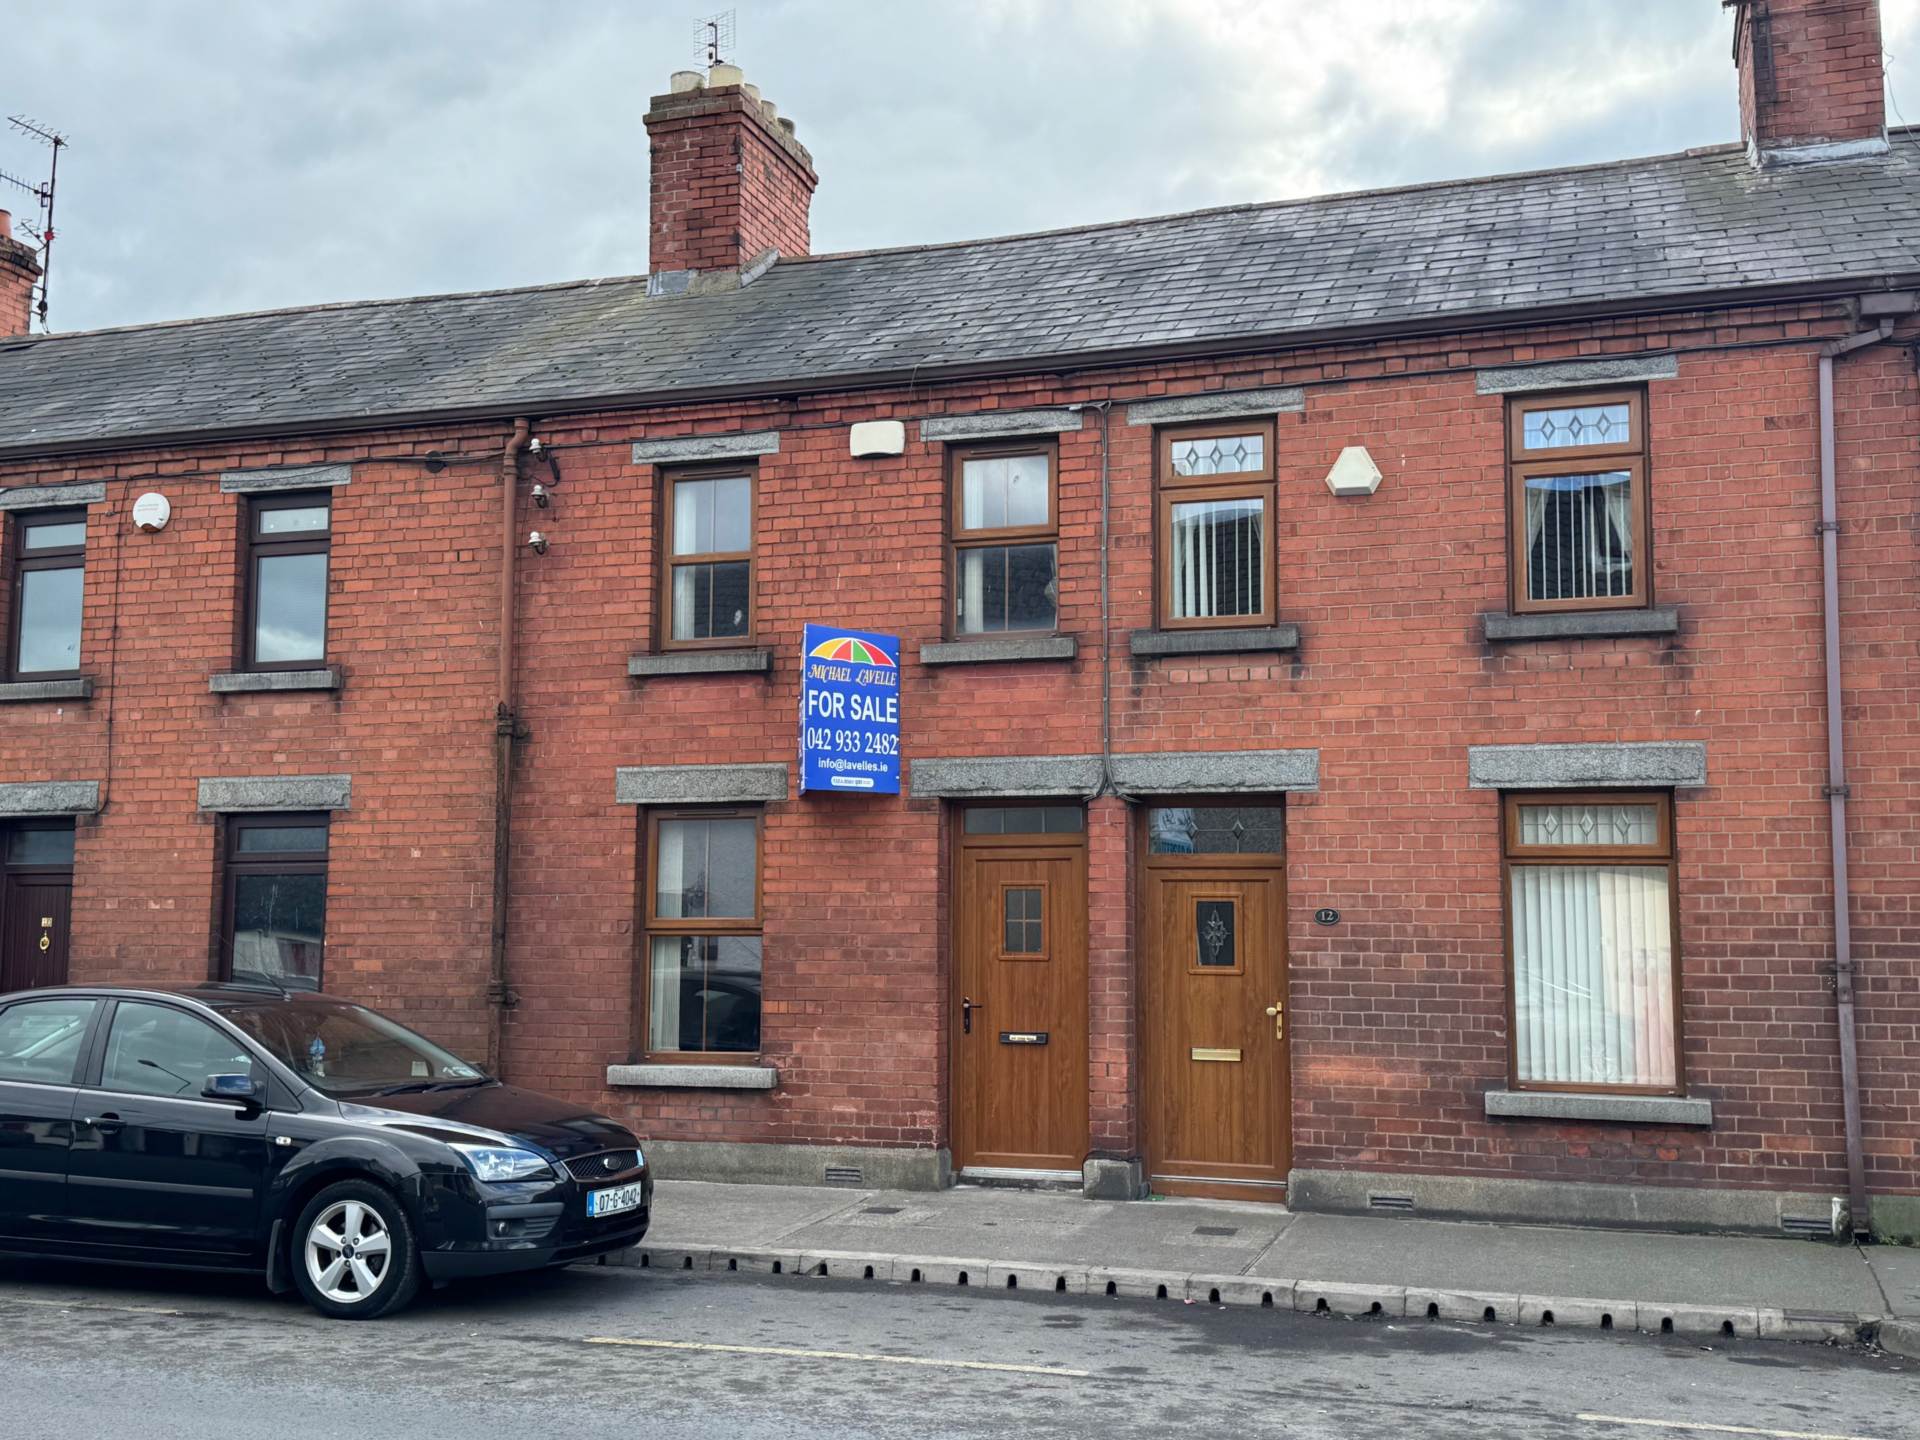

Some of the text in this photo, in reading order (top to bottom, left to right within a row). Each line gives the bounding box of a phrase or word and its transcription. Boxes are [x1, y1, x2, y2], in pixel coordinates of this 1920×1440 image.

[808, 664, 898, 686] MICHAEL LAVELLE
[808, 689, 898, 724] FOR SALE
[807, 726, 898, 755] 042 933 2482
[818, 757, 888, 772] info@lavelles.ie
[1321, 911, 1334, 921] 12
[599, 1188, 637, 1211] 07-G-4042
